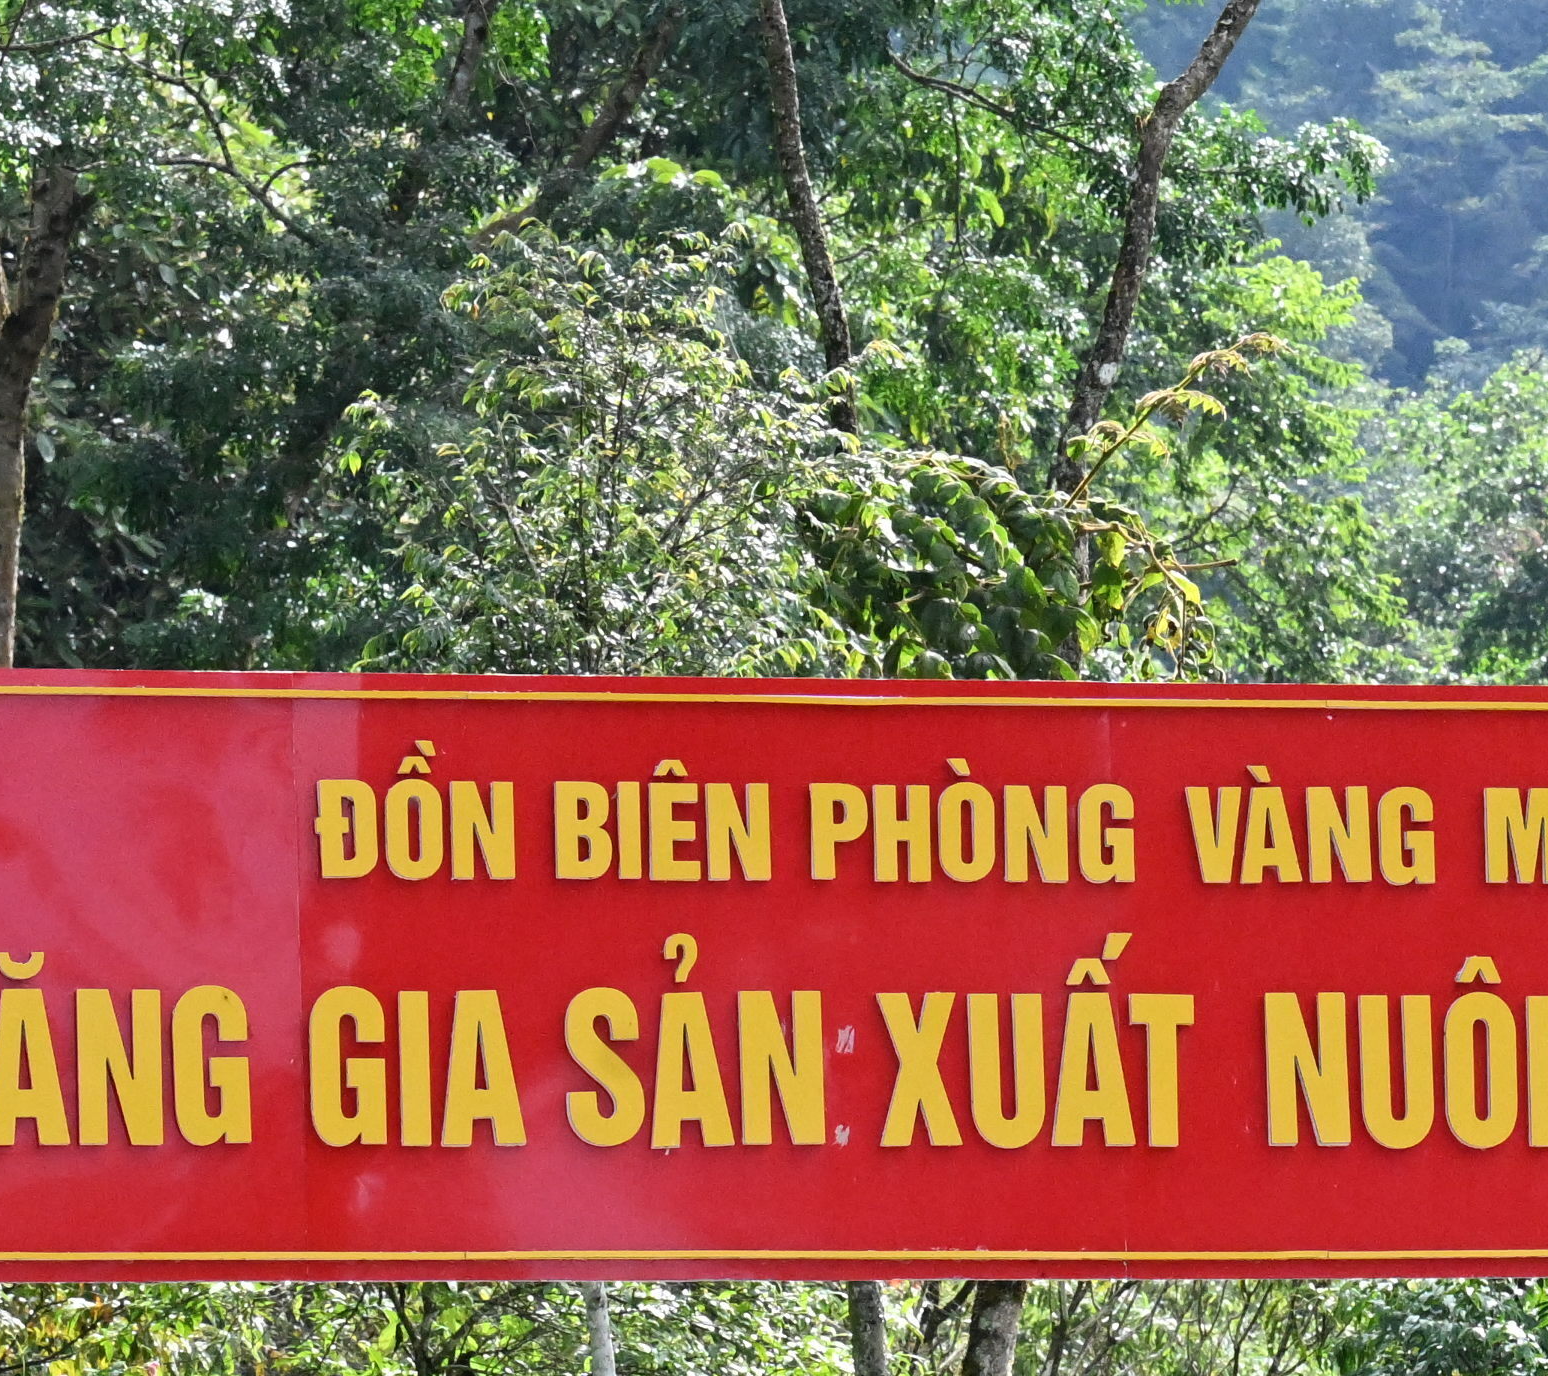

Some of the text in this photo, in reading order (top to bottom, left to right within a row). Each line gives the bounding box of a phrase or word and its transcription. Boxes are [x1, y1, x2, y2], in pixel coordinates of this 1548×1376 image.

[314, 739, 517, 881] ĐỒN
[554, 758, 772, 882] BIÊN
[810, 757, 1137, 883] PHÒNG
[1186, 764, 1437, 885] VÀNG
[309, 984, 528, 1148] GIA
[565, 932, 827, 1150] SẢN
[877, 931, 1196, 1149] XUẤT
